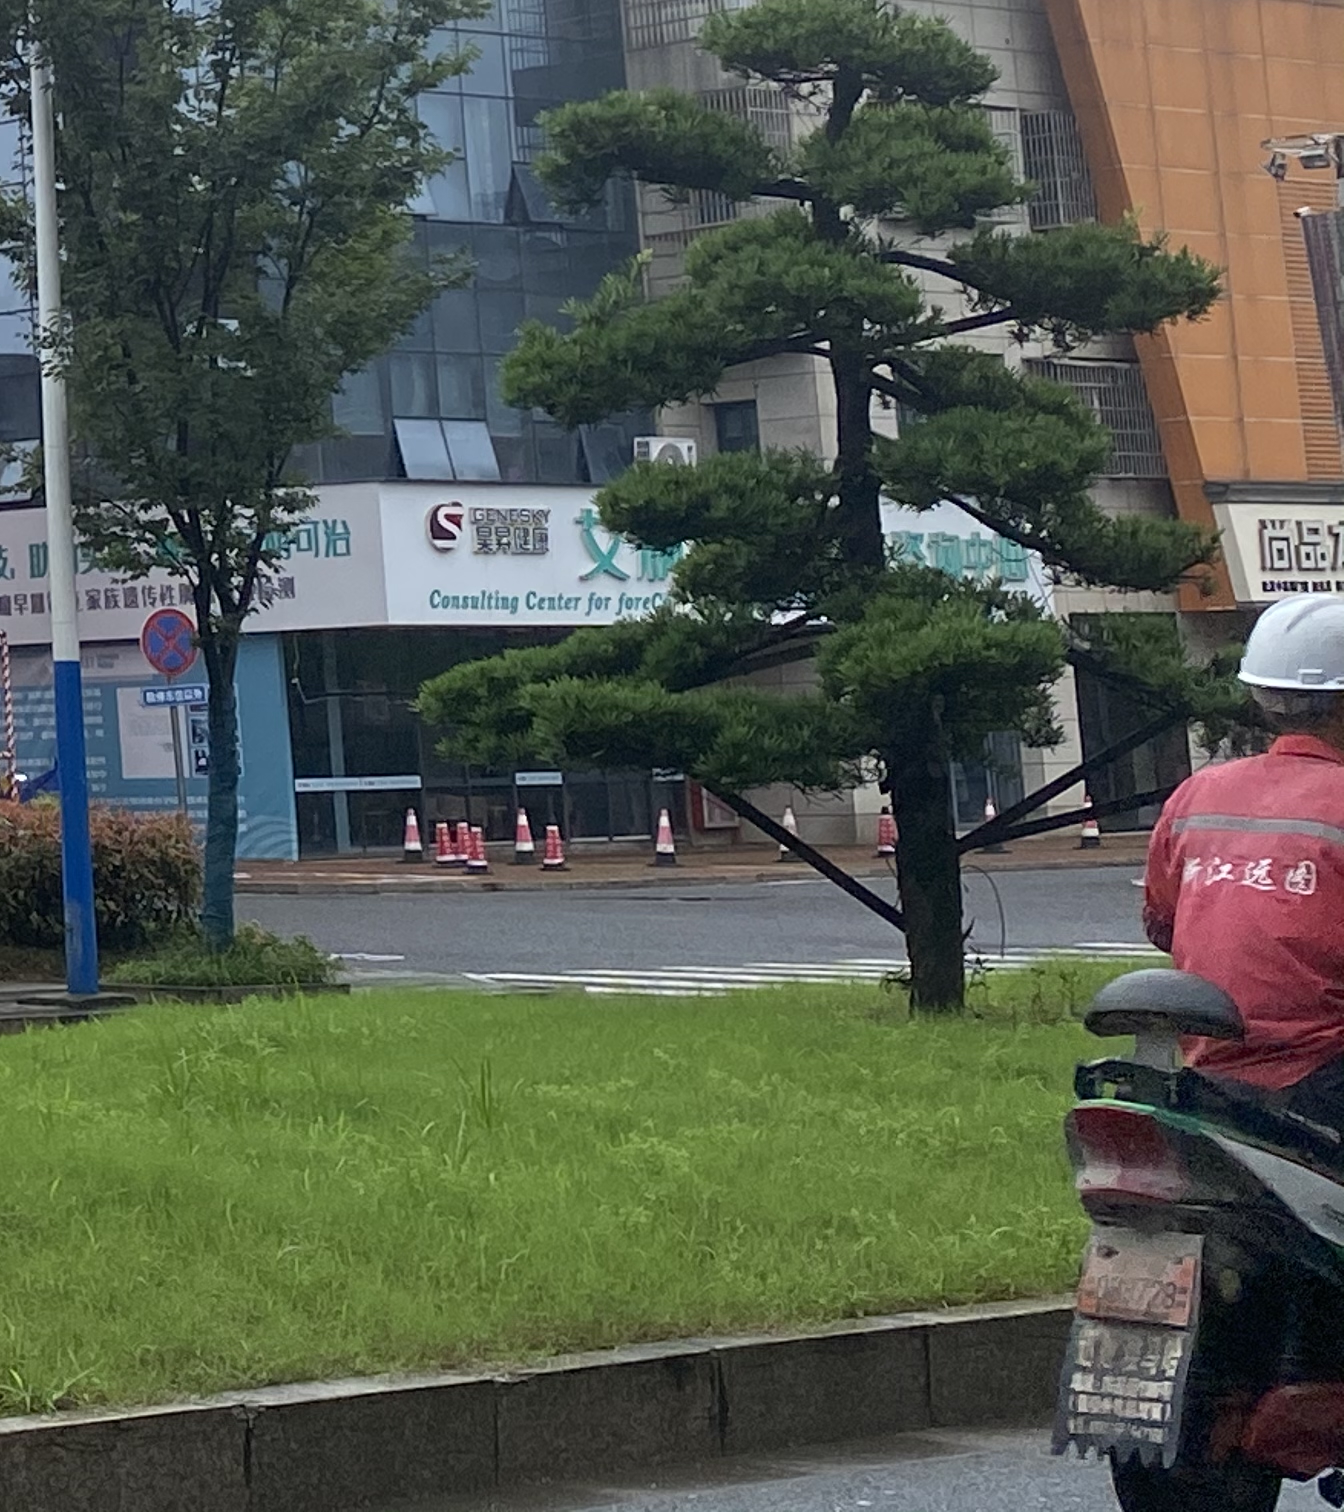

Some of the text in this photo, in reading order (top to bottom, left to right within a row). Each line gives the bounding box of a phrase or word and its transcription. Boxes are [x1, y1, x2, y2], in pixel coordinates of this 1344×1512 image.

[470, 507, 551, 524] GENESKY
[429, 589, 520, 614] Consulting
[525, 591, 581, 612] Center
[585, 591, 612, 617] for
